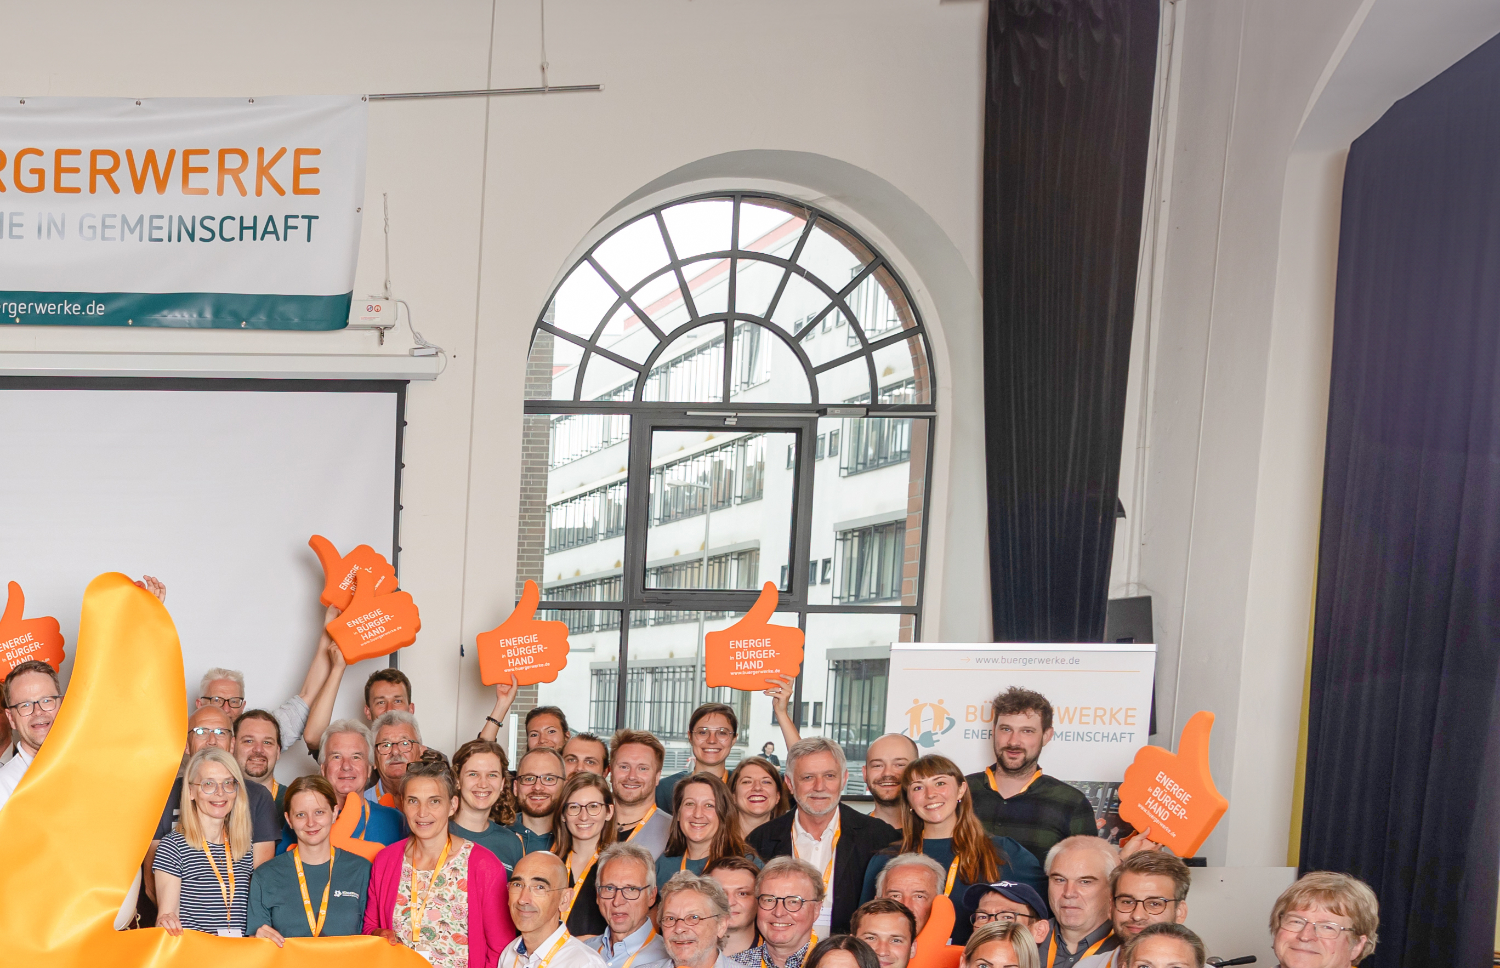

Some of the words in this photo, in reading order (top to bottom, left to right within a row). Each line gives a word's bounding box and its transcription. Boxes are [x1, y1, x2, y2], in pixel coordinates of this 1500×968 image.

[37, 211, 66, 241] IN
[78, 212, 320, 243] GEMEINSCHAFT
[345, 607, 384, 628] ENERGIE
[356, 614, 395, 634] BÜRGER-
[360, 625, 386, 641] HAND
[499, 633, 539, 648] ENERGIE
[5, 641, 45, 661] BÜRGER-
[506, 644, 548, 658] BÜRGER-
[729, 638, 772, 649] ENERGIE
[507, 655, 535, 667] HAND
[735, 649, 781, 660] BÜRGER-
[975, 655, 1081, 667] www.buergerwerke.de
[735, 660, 764, 670] HAND
[1052, 731, 1135, 743] MEINSCHAFT
[1155, 770, 1192, 805] ENERGIE
[1144, 796, 1170, 821] HAND
[1151, 786, 1188, 820] BÜRGER-
